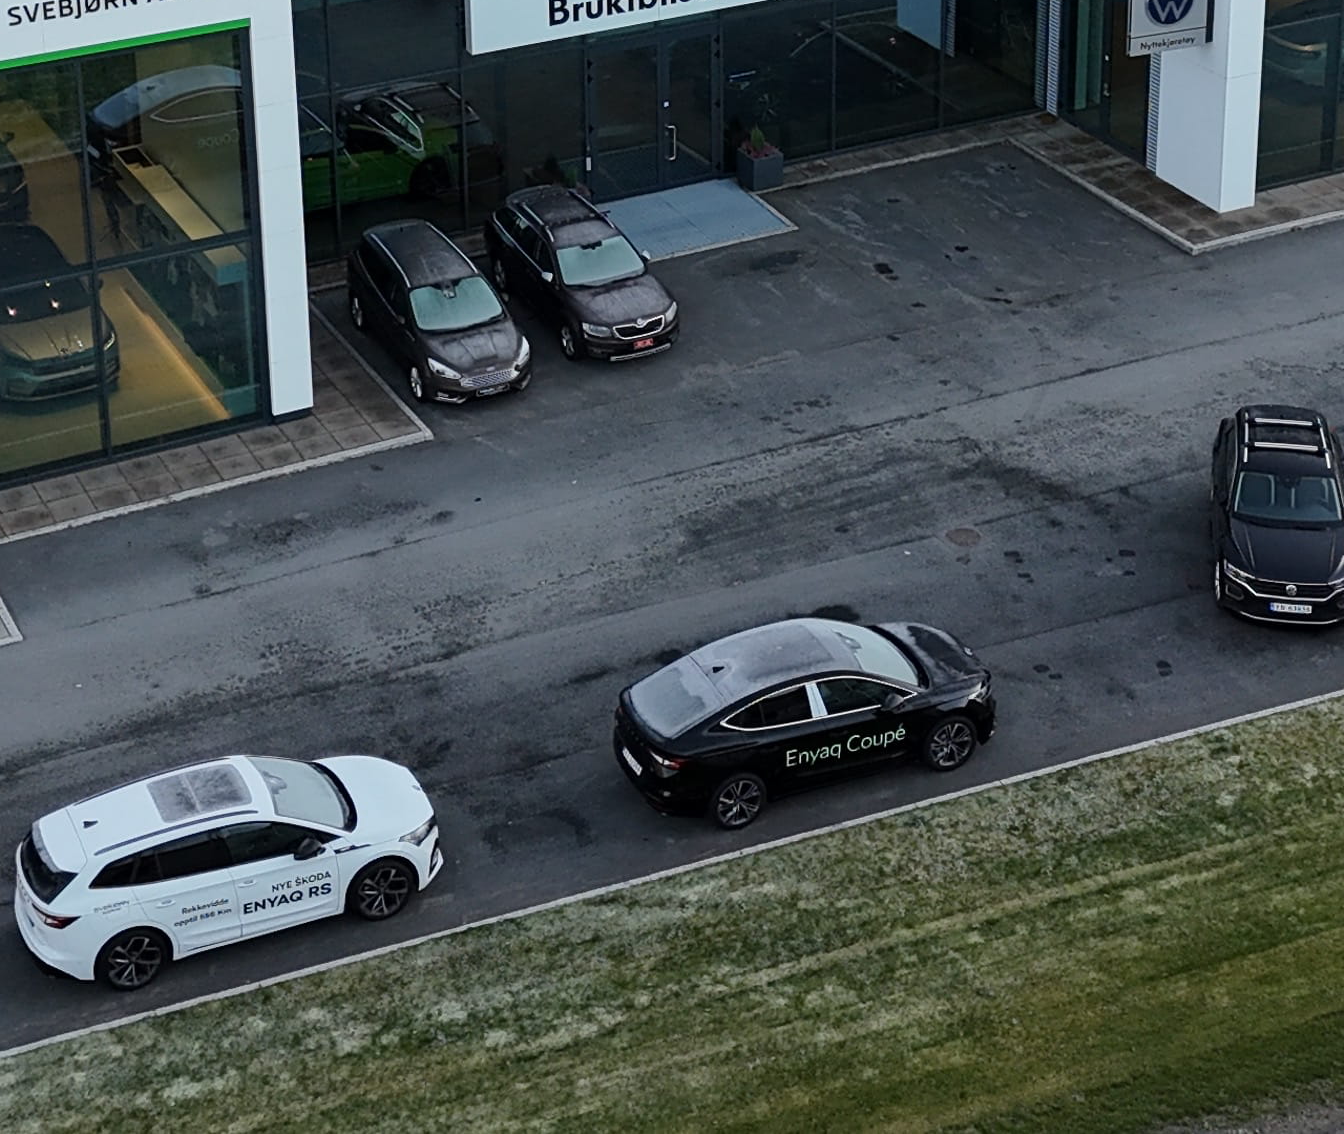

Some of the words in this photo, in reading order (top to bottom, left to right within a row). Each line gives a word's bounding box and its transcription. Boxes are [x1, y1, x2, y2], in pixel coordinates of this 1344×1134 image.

[786, 744, 842, 767] Enyaq
[846, 723, 906, 752] Coupé
[271, 880, 292, 893] NYE
[294, 870, 331, 887] ŠKODA
[181, 898, 229, 914] Rekkevidde
[243, 890, 304, 914] ENYAQ
[308, 883, 332, 899] RS
